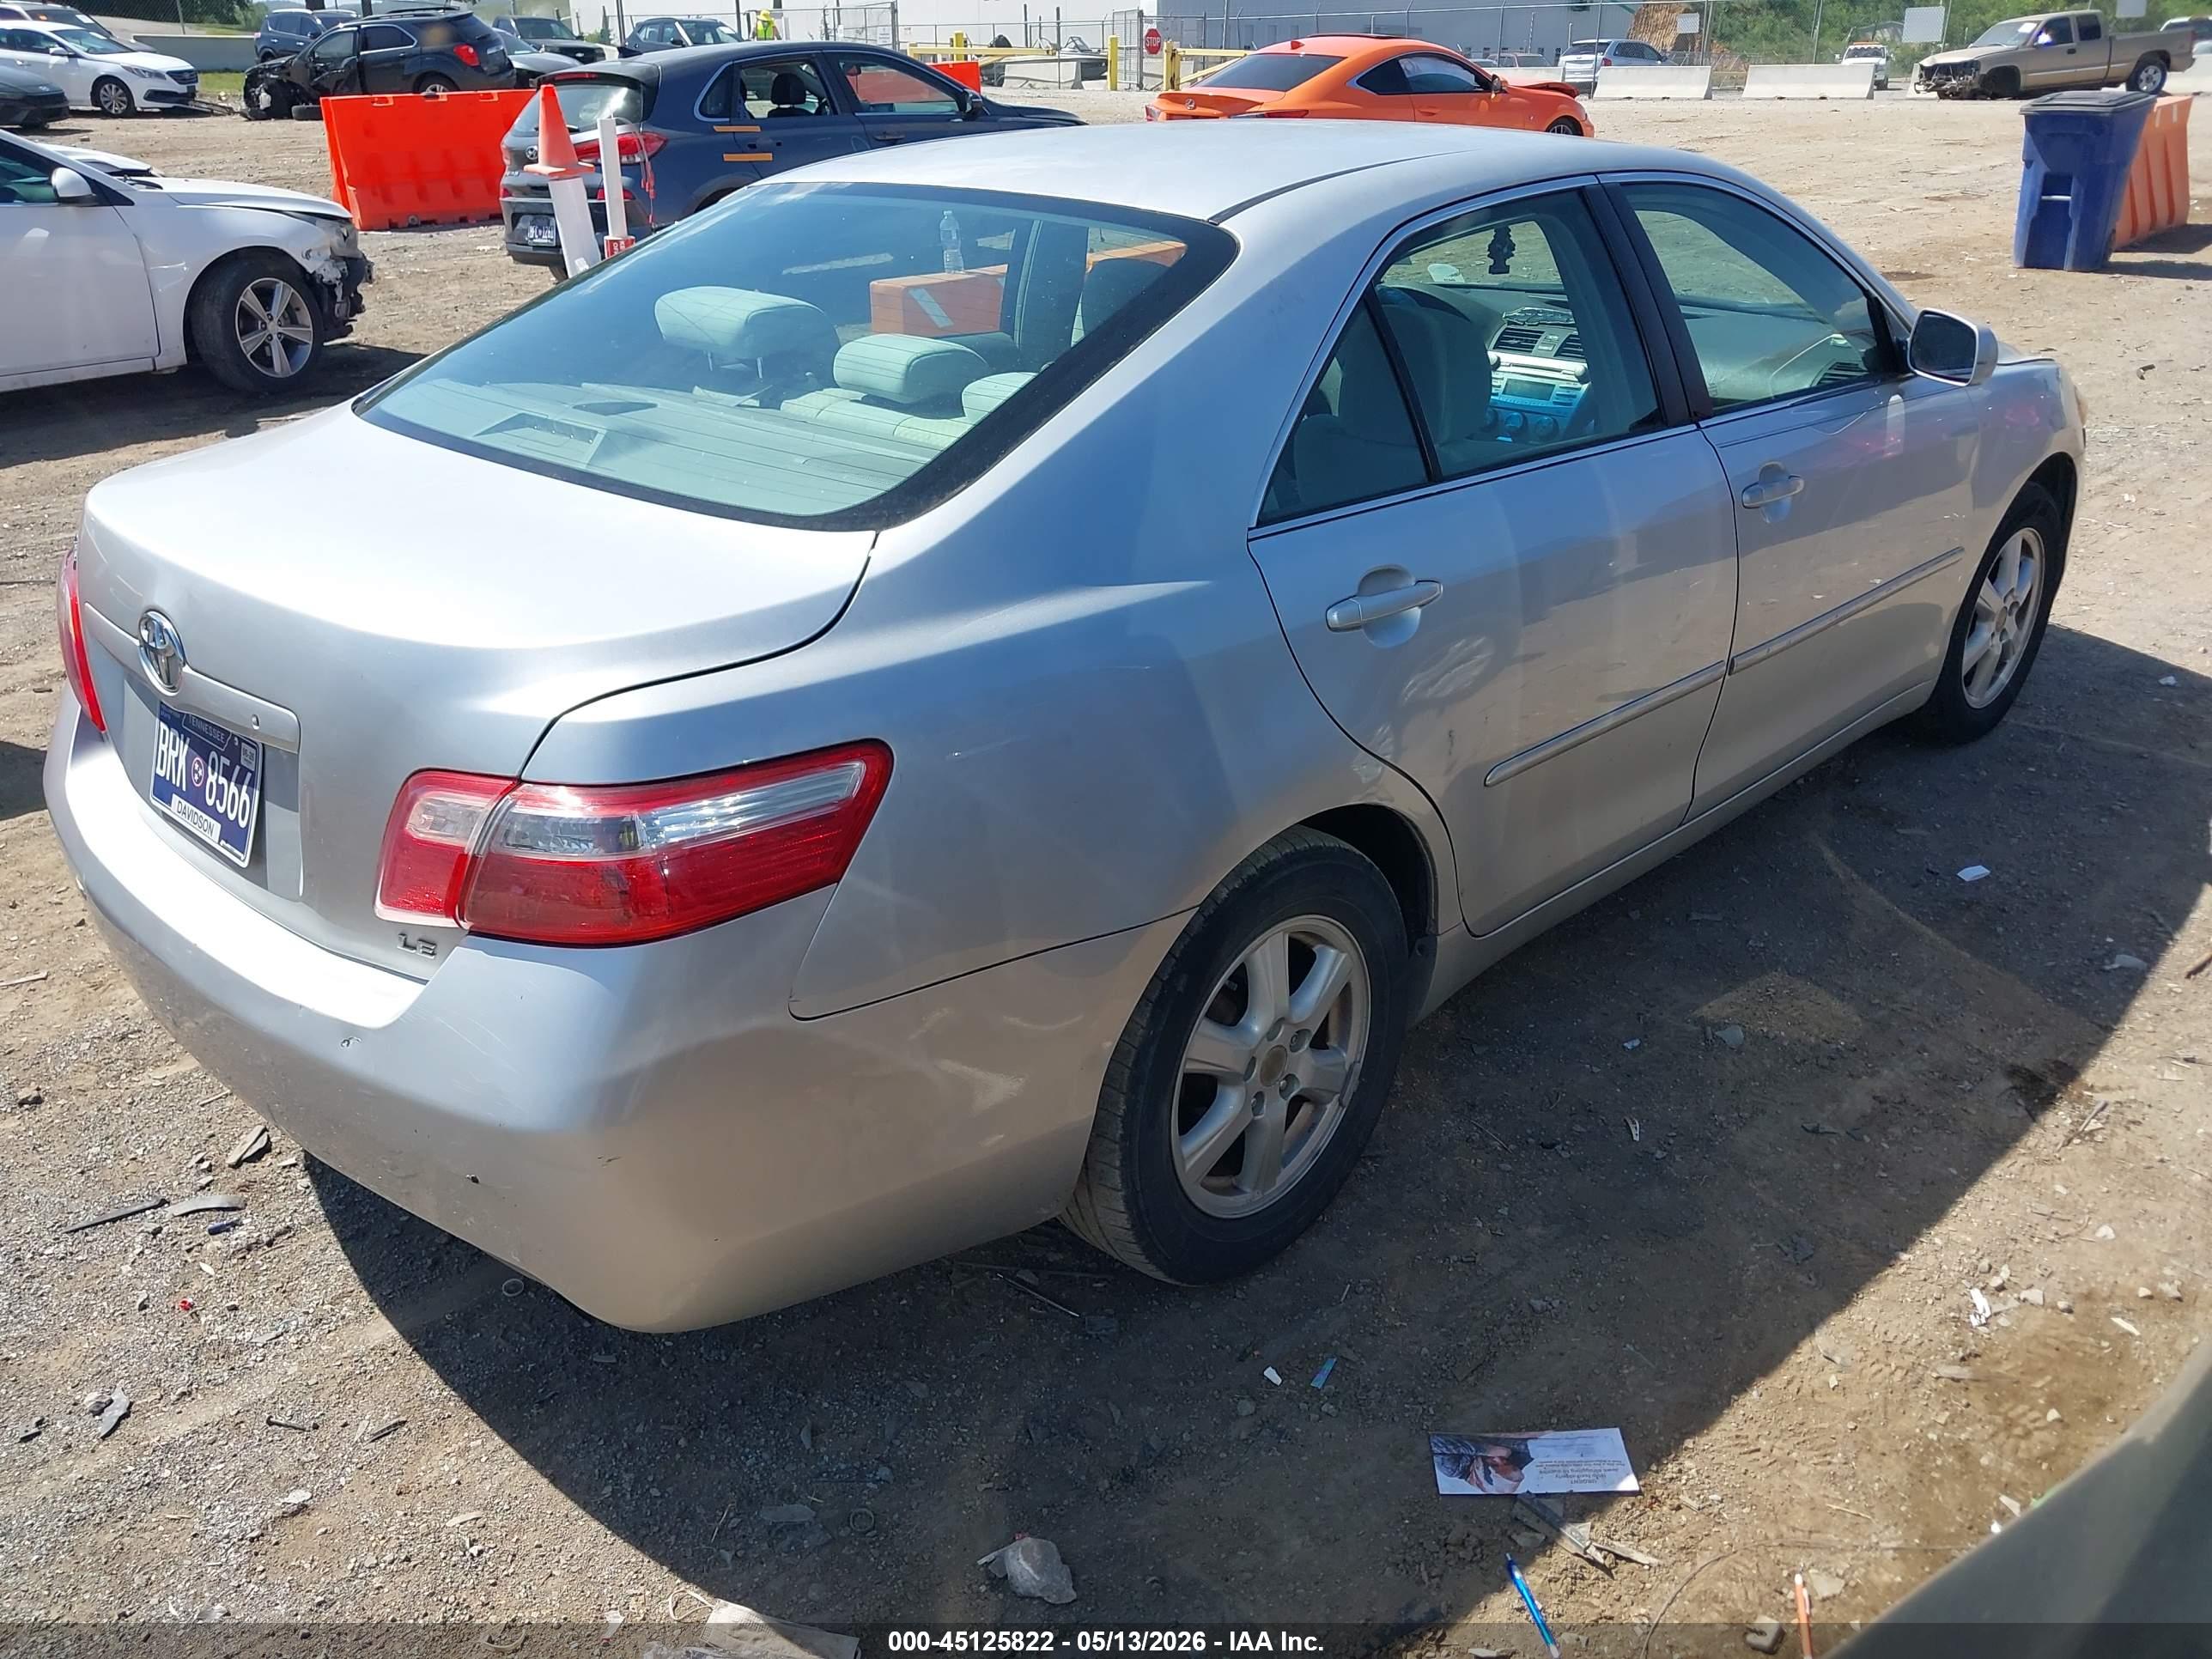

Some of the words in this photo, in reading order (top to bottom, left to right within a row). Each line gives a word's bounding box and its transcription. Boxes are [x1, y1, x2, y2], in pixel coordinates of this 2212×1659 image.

[1146, 36, 1161, 47] STOP
[155, 721, 191, 792] BRK
[204, 750, 252, 829] 8566
[176, 800, 215, 838] DAVIDSON
[397, 933, 437, 959] LE
